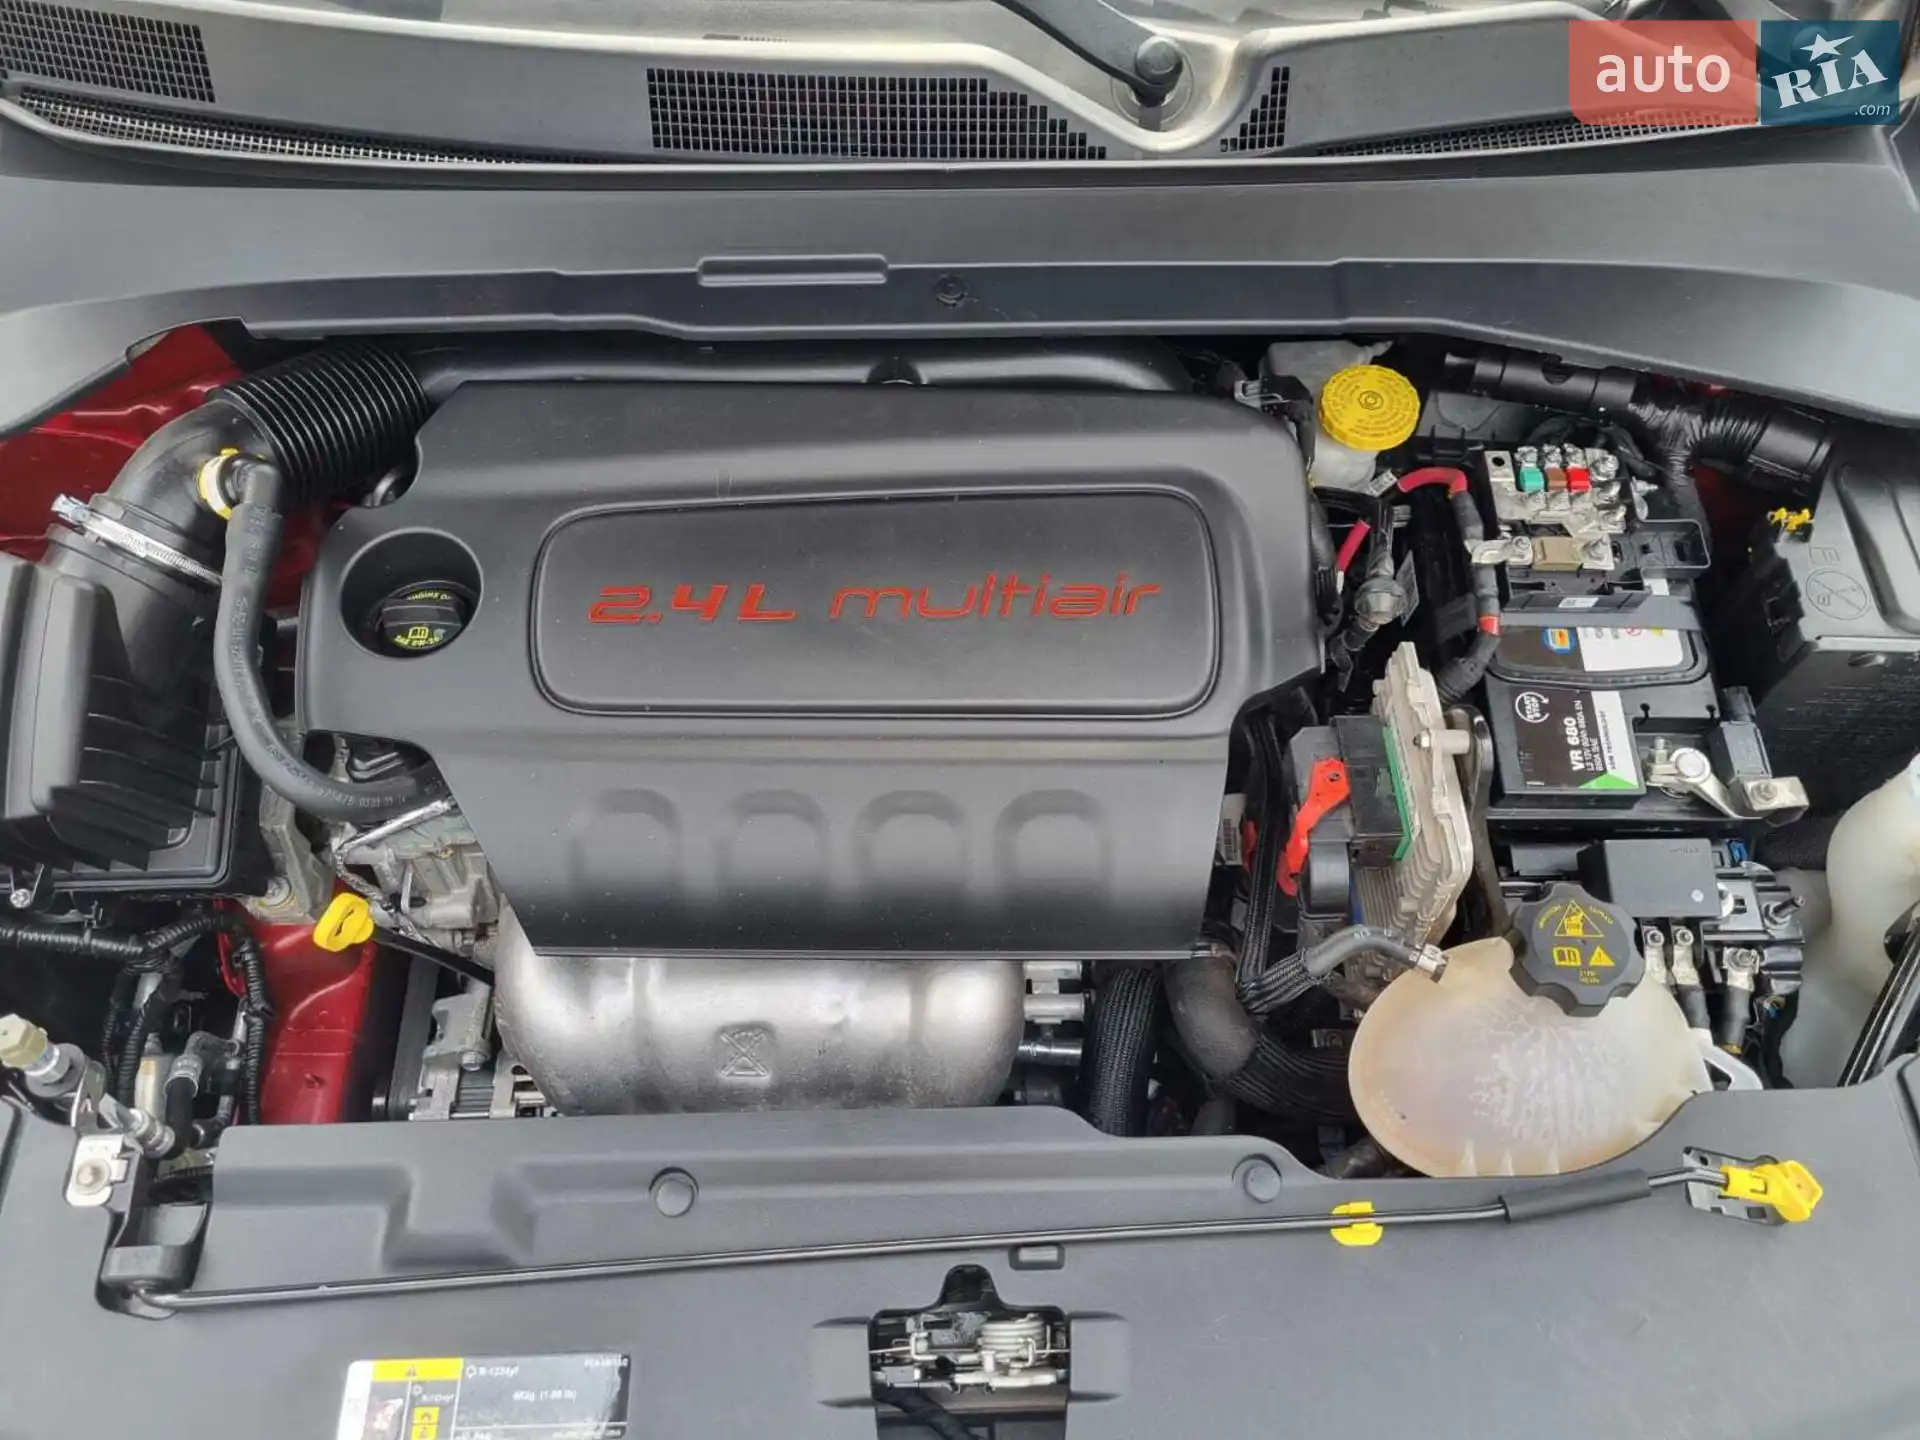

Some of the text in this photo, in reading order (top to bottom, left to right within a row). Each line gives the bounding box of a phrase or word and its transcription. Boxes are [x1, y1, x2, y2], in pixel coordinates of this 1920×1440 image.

[828, 571, 1162, 619] multiair
[1563, 716, 1586, 771] VR 680
